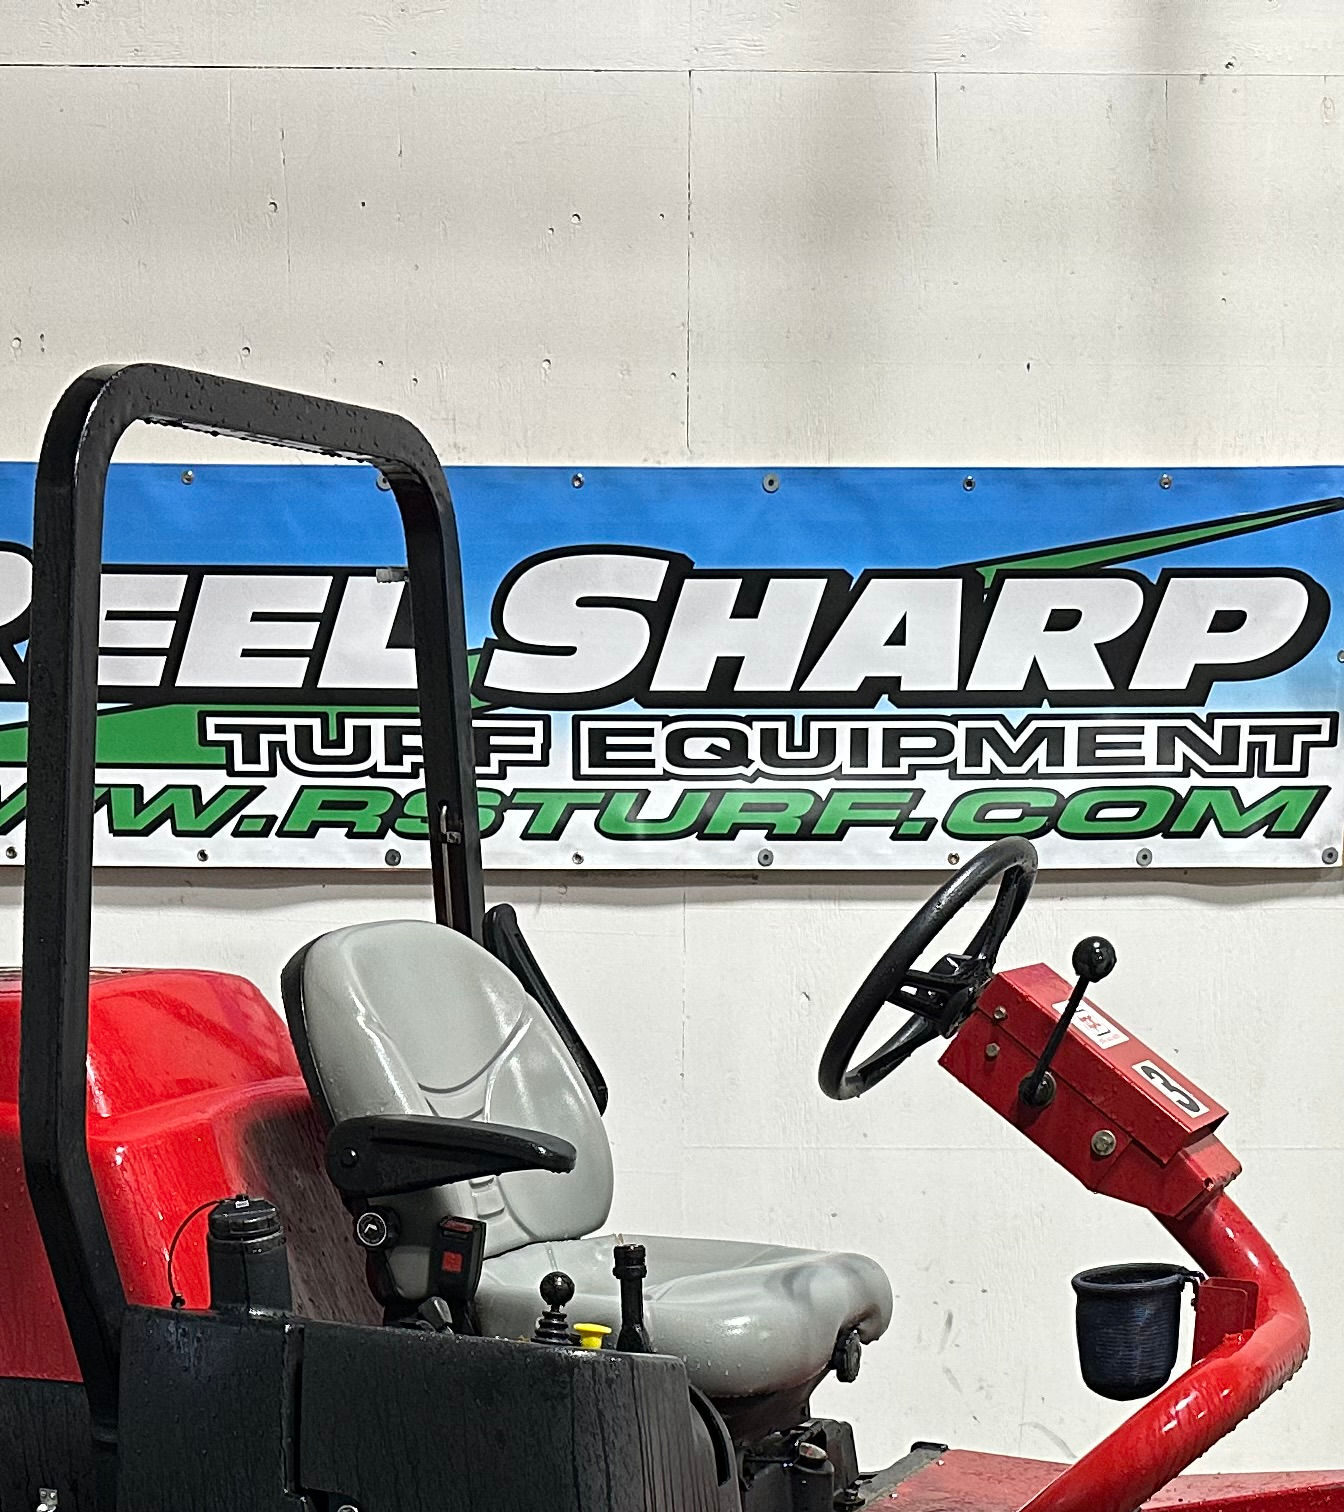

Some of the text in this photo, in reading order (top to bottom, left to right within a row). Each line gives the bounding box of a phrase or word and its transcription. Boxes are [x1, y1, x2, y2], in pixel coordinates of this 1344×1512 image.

[470, 544, 1331, 708] SHARP
[573, 711, 1339, 781] EQUIPMENT
[1141, 1065, 1201, 1113] 3
